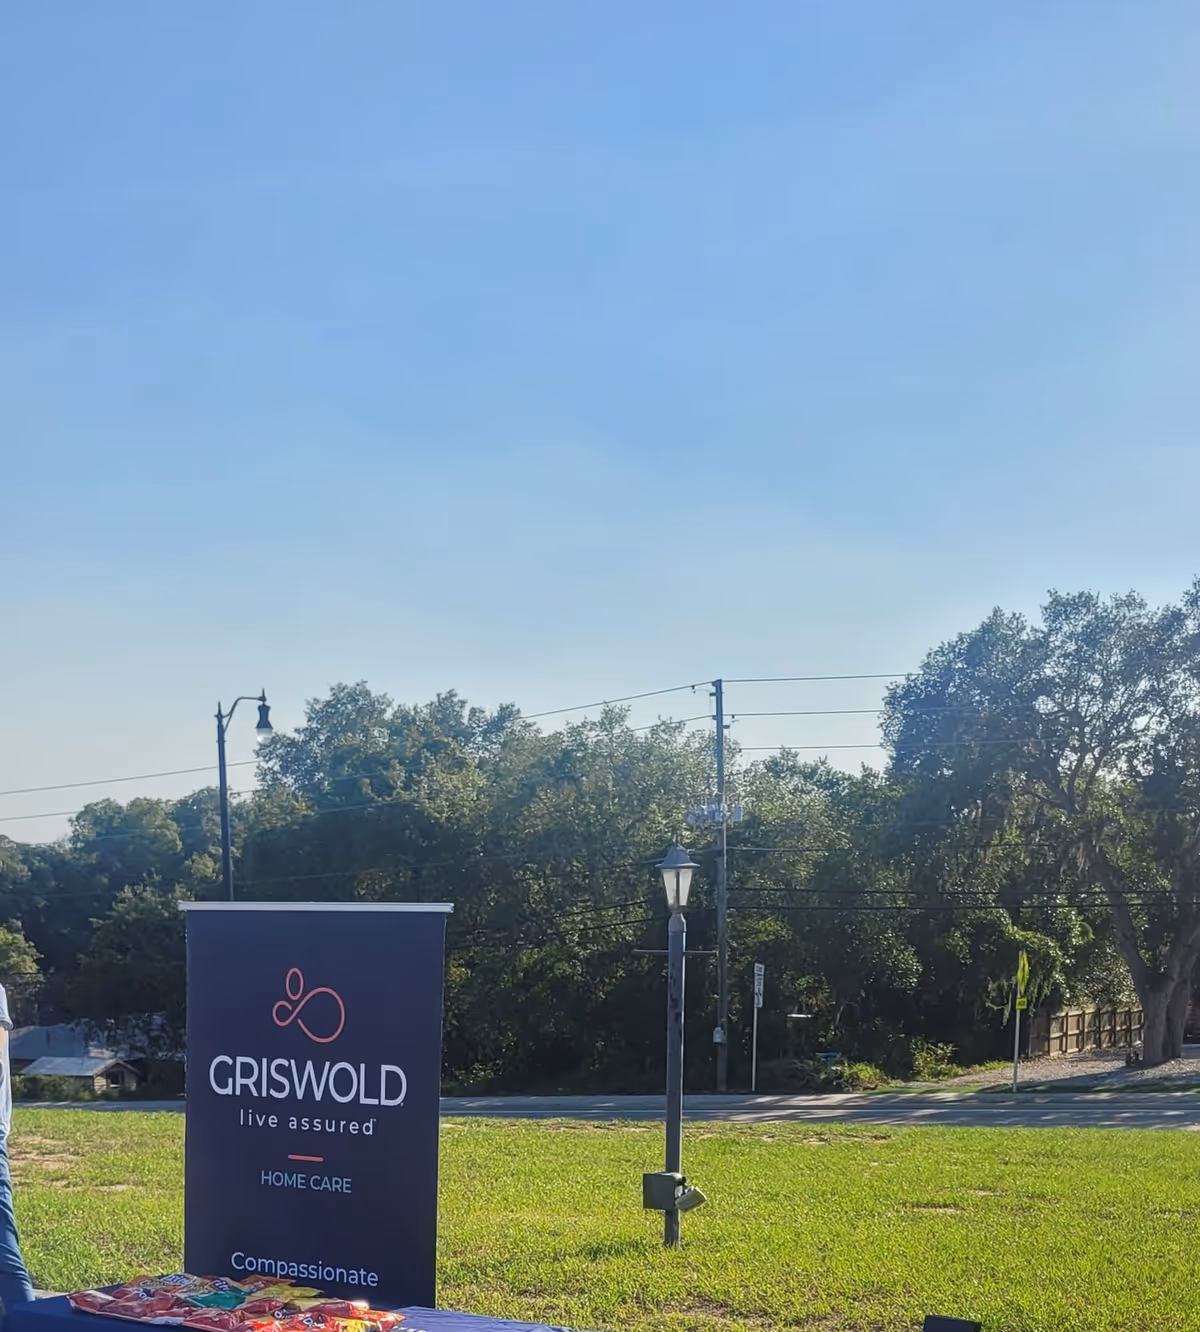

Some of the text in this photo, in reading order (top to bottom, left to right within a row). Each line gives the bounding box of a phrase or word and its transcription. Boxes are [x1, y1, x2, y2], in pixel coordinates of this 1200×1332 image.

[209, 1054, 407, 1107] GRISWOLD
[239, 1108, 374, 1136] live assured
[261, 1170, 352, 1194] HOME CARE
[230, 1251, 380, 1288] Compassionate
